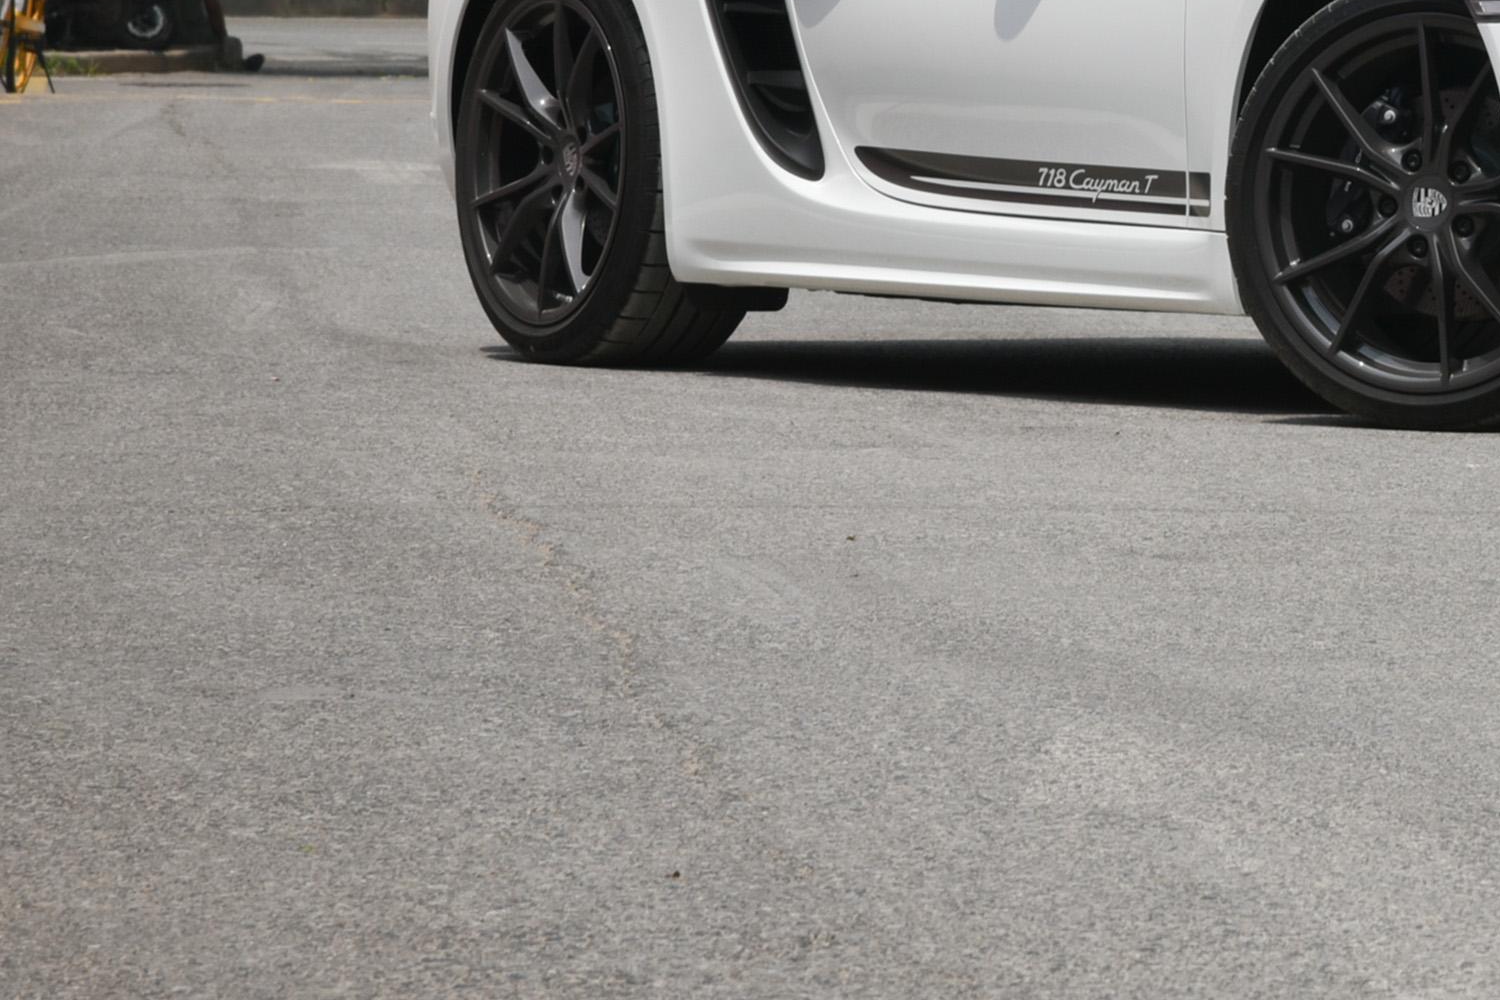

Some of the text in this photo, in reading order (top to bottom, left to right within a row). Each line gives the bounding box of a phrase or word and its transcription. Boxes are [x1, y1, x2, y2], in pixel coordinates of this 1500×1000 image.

[1038, 167, 1159, 203] 718 Cayman T
